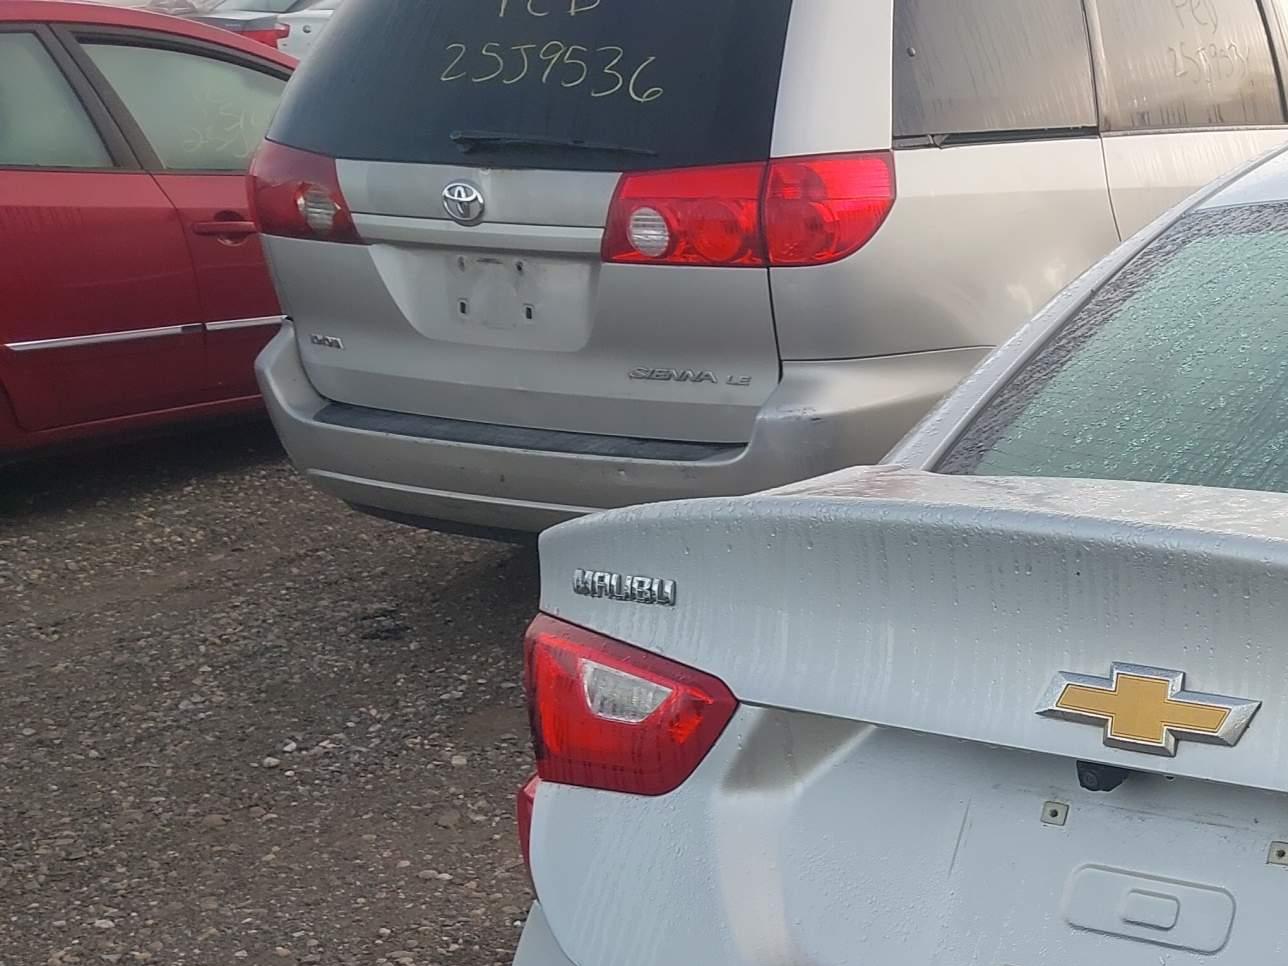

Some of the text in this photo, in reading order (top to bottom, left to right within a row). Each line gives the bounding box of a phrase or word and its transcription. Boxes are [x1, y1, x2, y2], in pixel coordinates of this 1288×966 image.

[440, 40, 664, 103] 25J9536
[629, 367, 752, 386] SIENNA LE
[573, 568, 677, 606] MALIBU
